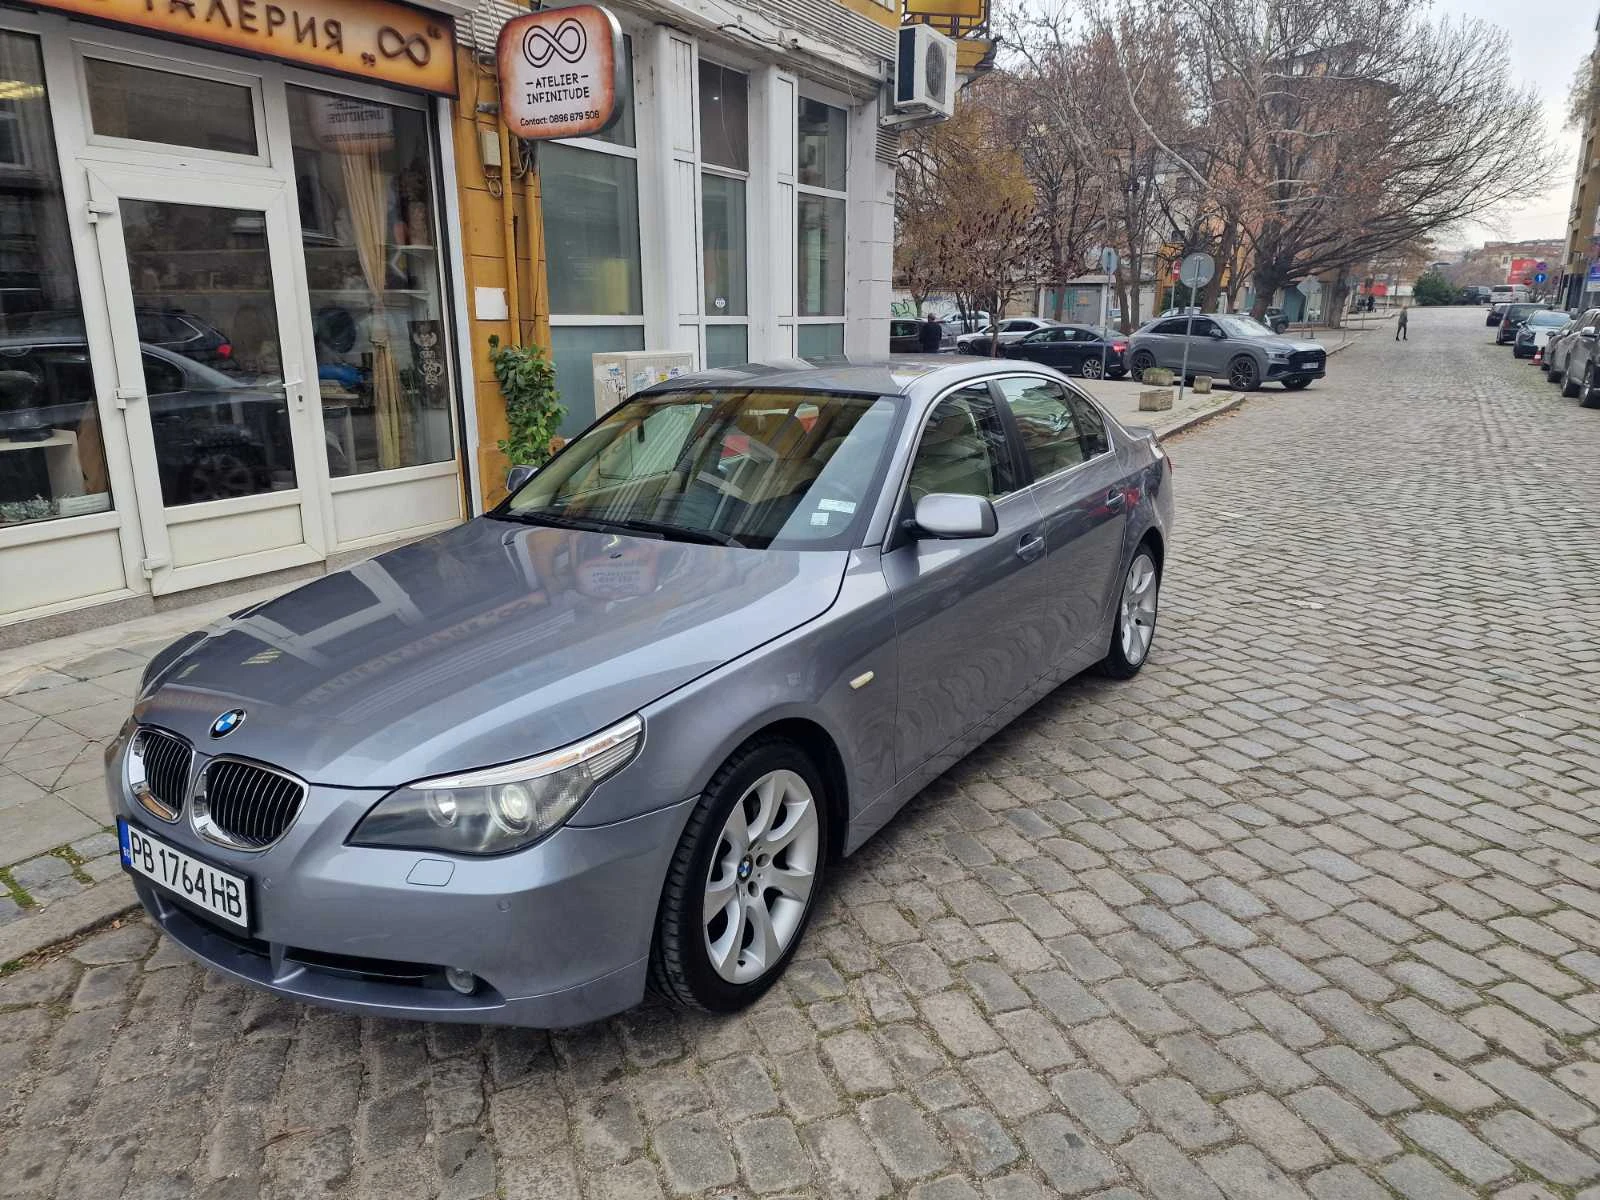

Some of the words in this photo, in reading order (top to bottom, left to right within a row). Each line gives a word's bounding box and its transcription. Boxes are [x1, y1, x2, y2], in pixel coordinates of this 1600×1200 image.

[527, 86, 590, 105] INFINITUDE
[520, 116, 548, 126] Contact:
[549, 113, 569, 123] 0896
[585, 110, 600, 120] 508
[159, 848, 207, 902] 1764
